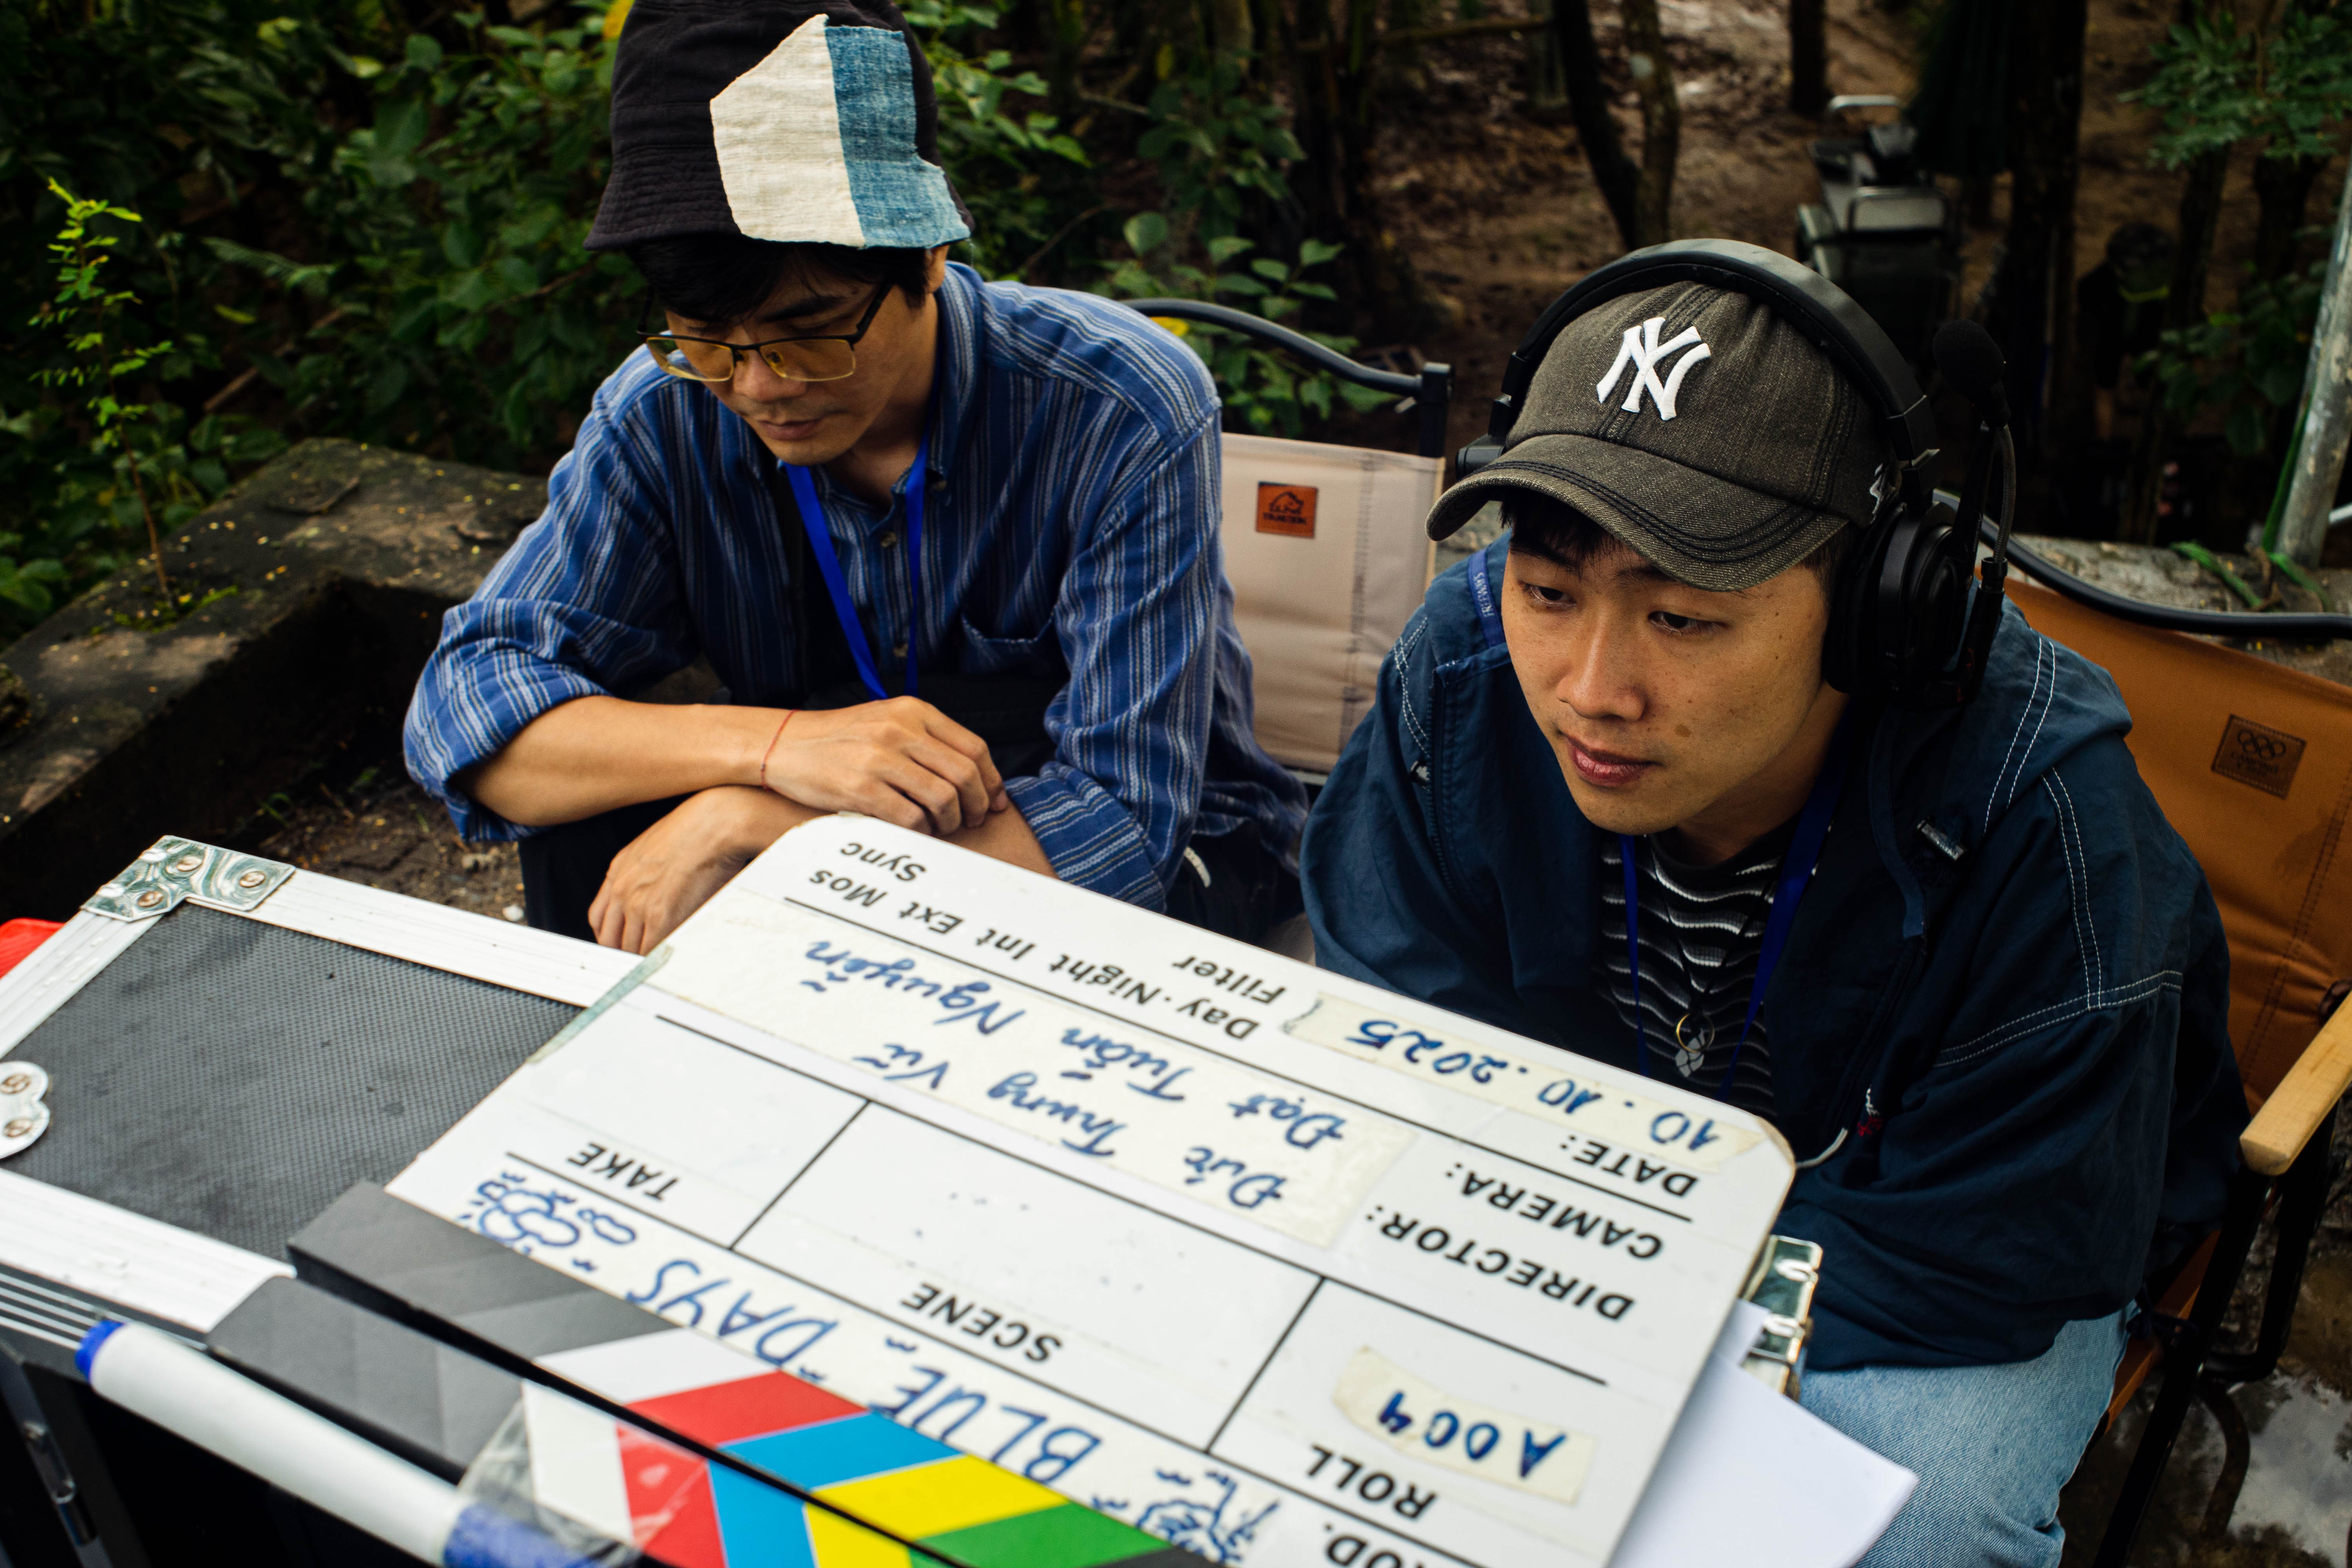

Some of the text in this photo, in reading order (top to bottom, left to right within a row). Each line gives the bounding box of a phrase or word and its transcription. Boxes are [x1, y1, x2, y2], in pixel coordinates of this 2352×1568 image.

[809, 869, 887, 908] Mos
[839, 842, 927, 882] Sync
[898, 901, 964, 935] Ext
[975, 927, 1036, 961] Int
[1172, 956, 1287, 1005] Filter
[852, 1043, 949, 1091] Vũ
[986, 1073, 1131, 1159] Trung
[566, 1142, 678, 1201] TAKE
[1559, 1134, 1700, 1200] DATE:
[1445, 1162, 1664, 1261] CAMERA:
[1366, 1205, 1636, 1323] DIRECTOR:
[901, 1288, 1063, 1364] SCENE
[625, 1259, 1102, 1484] BLUE DAYS
[1307, 1444, 1438, 1523] ROLL
[1323, 1523, 1427, 1568] OD.
